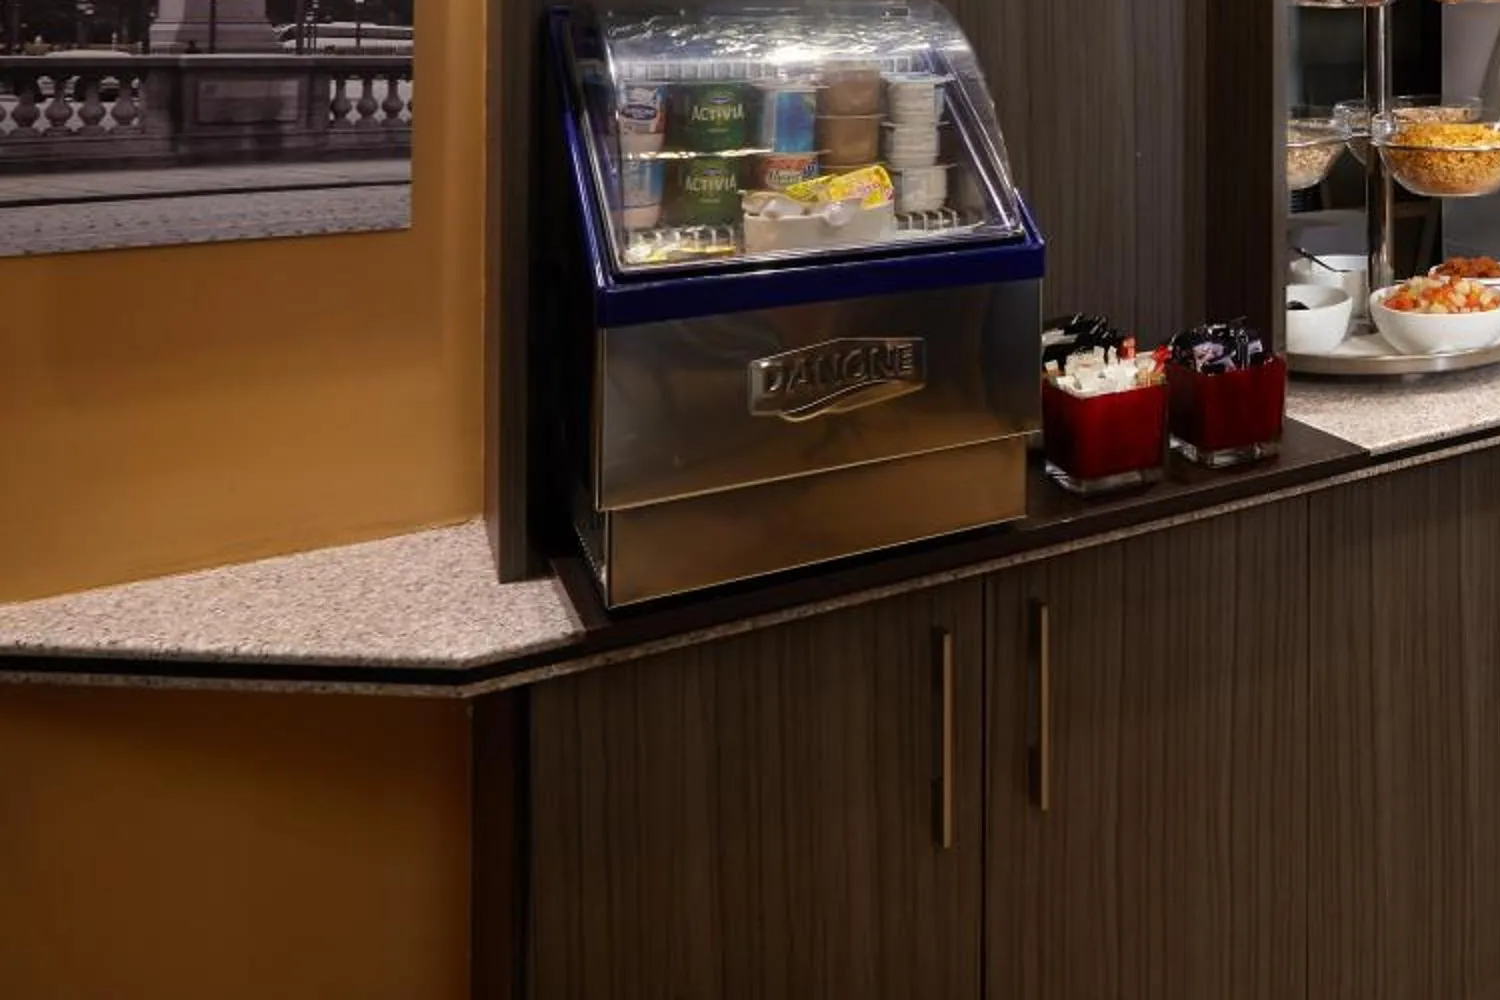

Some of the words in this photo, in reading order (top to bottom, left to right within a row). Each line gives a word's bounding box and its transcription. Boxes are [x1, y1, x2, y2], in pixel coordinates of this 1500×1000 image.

[691, 103, 745, 121] ACTIVIA
[685, 174, 737, 193] ACTIVIA
[763, 343, 913, 397] DANONE
